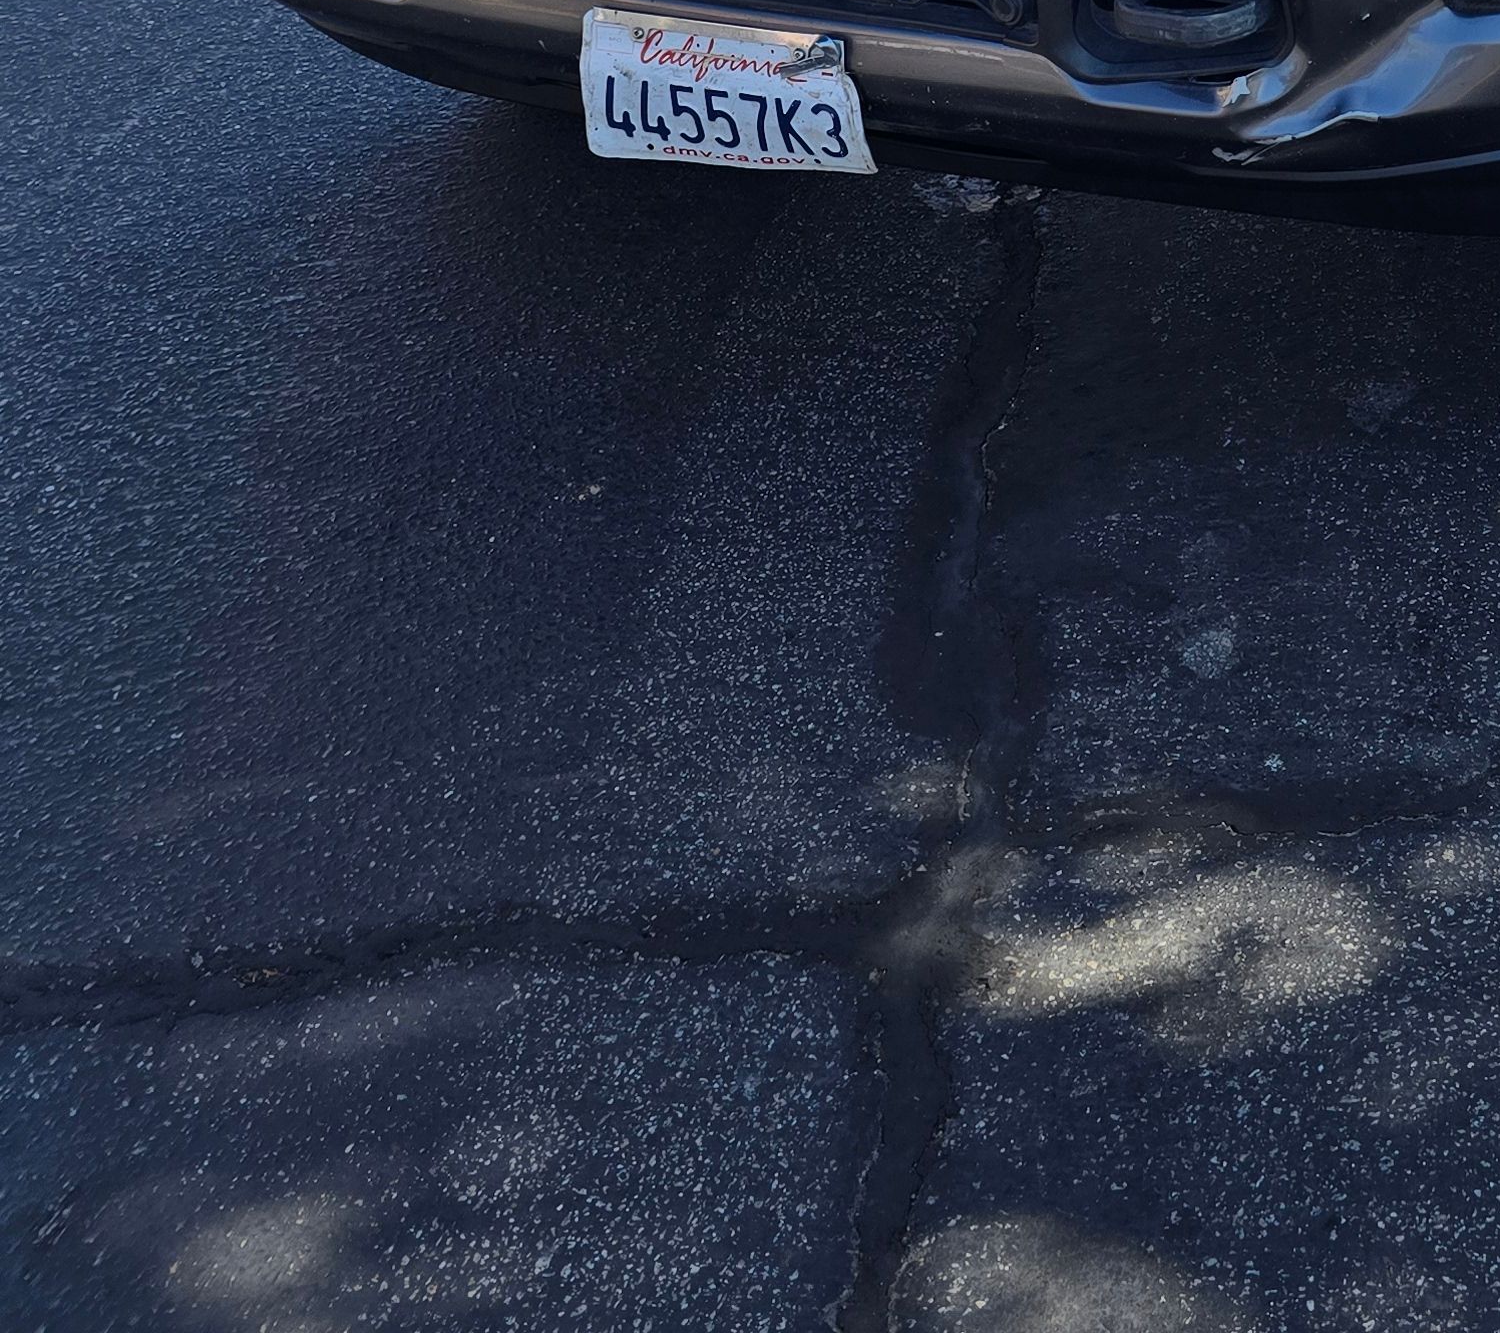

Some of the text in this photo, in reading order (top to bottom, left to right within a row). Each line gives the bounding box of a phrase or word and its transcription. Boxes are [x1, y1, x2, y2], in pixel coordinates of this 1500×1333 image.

[640, 29, 807, 82] California
[605, 75, 849, 158] 44557K3
[662, 144, 805, 165] dmv.ca.gov
